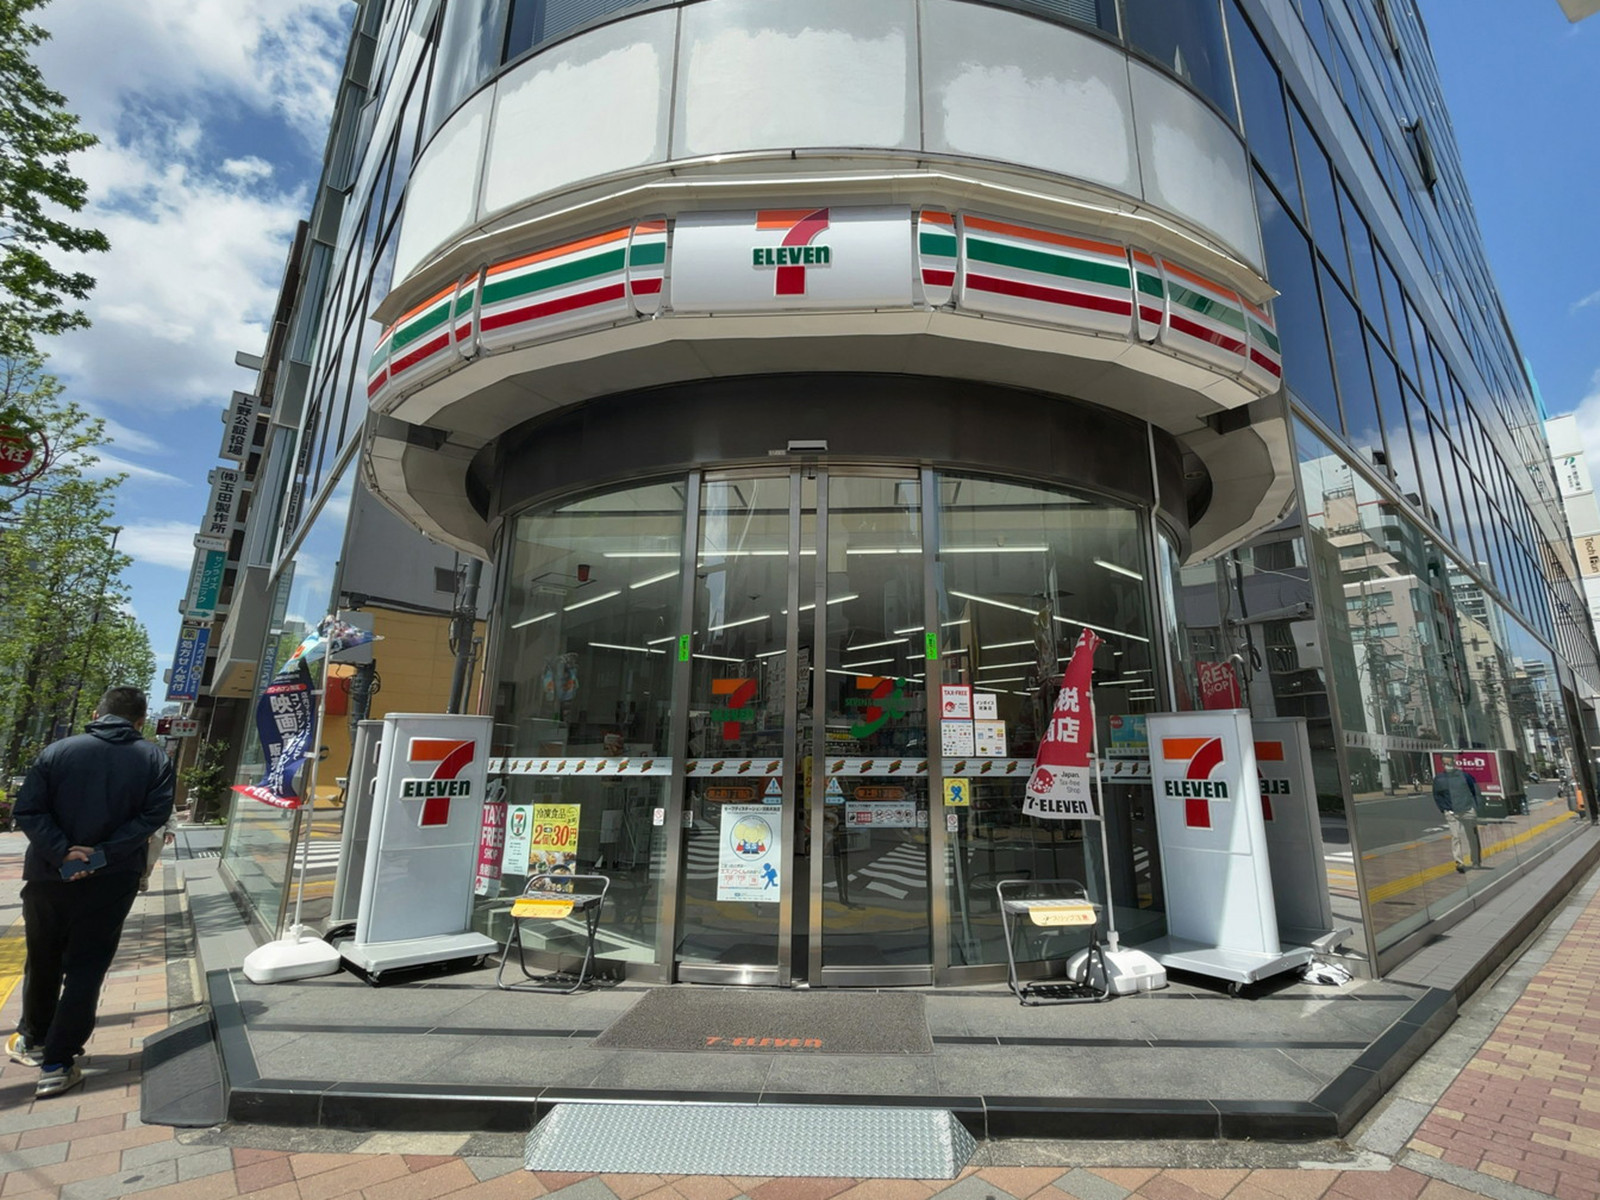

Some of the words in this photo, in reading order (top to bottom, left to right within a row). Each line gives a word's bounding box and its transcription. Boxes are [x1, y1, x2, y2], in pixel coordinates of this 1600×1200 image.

[227, 396, 253, 456] 上野公証役場
[172, 640, 193, 692] 処方せん受付
[410, 739, 476, 827] 7
[1161, 737, 1225, 828] 7
